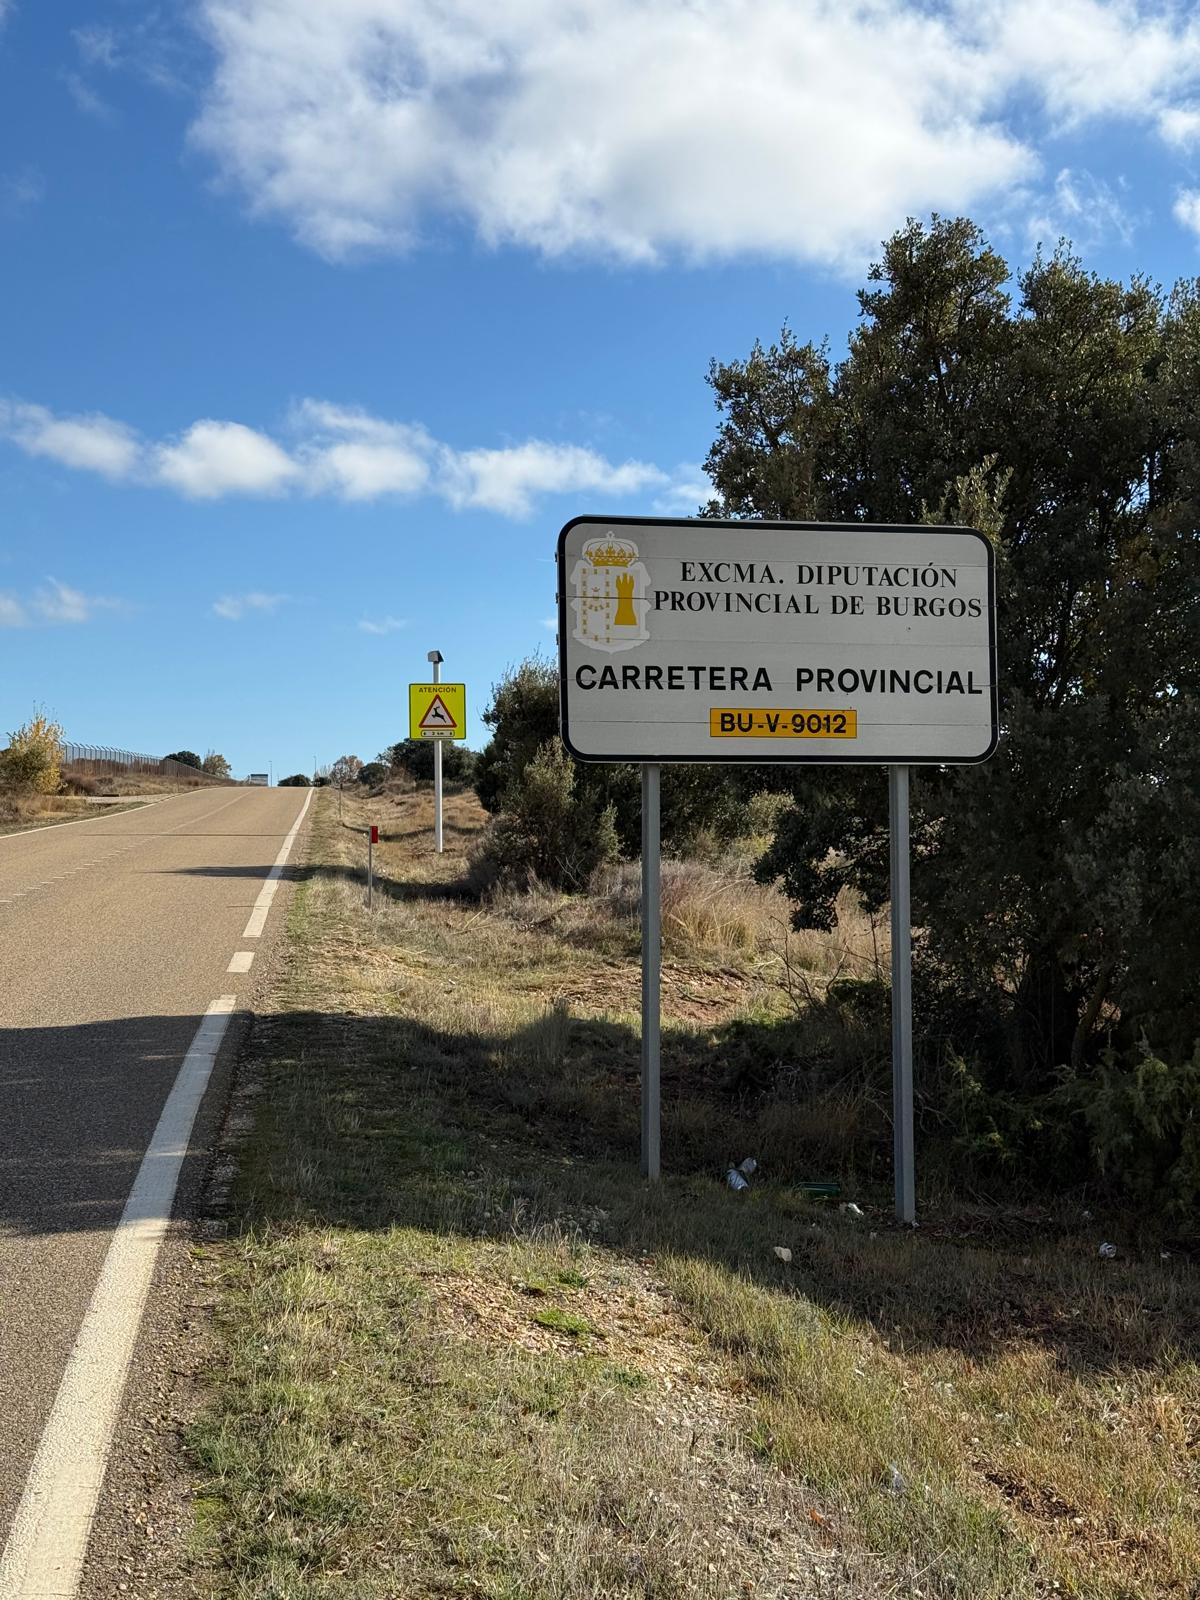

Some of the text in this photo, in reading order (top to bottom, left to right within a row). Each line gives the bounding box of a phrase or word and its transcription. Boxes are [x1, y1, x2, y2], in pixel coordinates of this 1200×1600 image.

[680, 561, 957, 588] EXCMA. DIPUTACIÓN
[653, 590, 982, 618] PROVINCIAL DE BURGOS
[575, 664, 983, 694] CARRETERA PROVINCIAL
[719, 711, 847, 735] BU-V-9012
